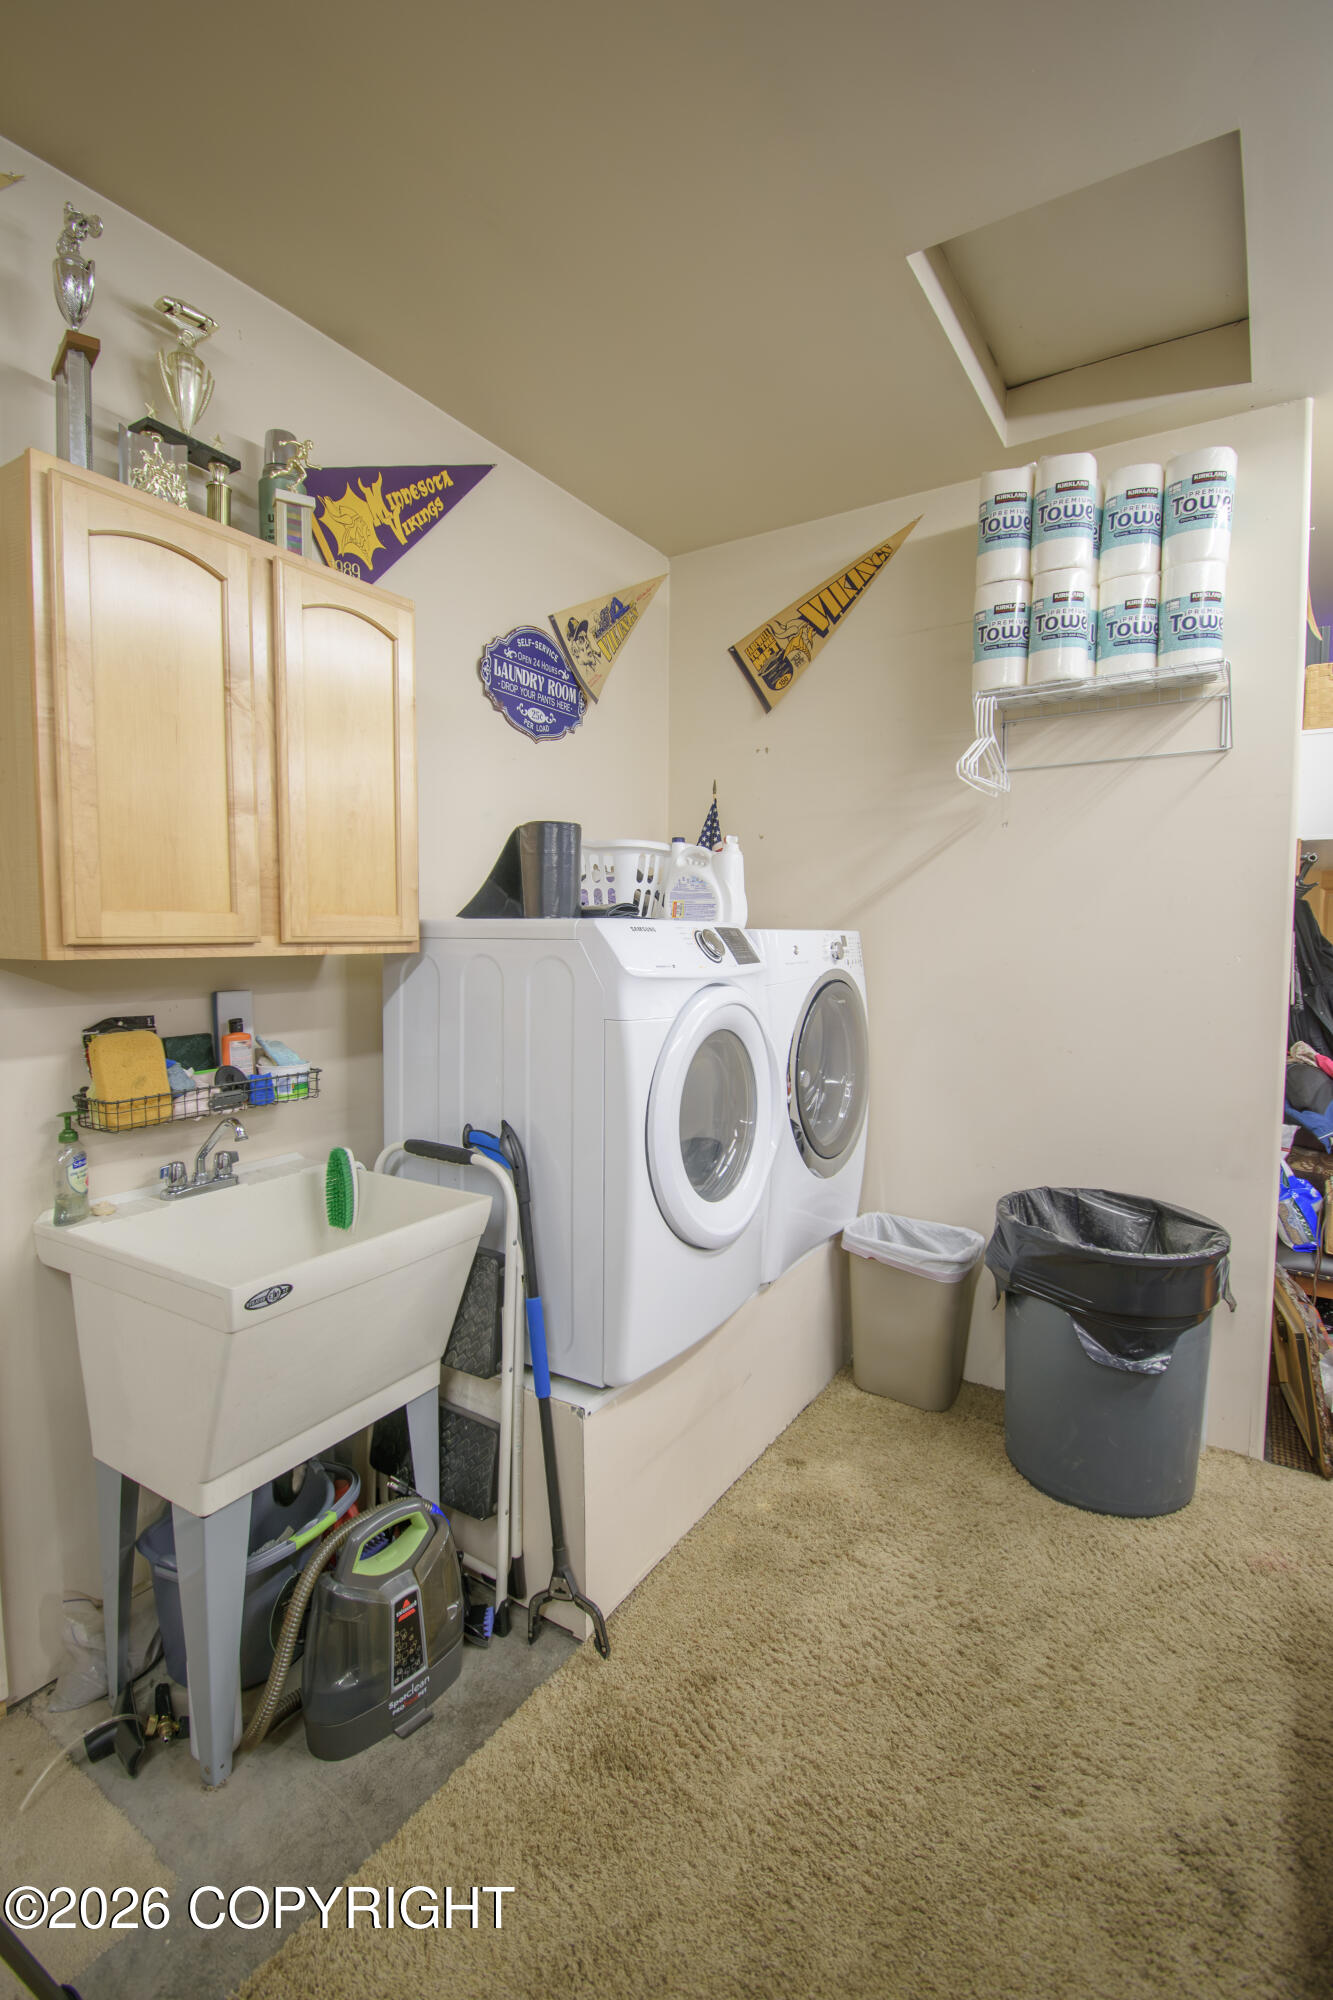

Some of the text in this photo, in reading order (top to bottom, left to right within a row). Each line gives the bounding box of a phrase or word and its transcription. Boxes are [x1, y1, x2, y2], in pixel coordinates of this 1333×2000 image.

[1193, 471, 1226, 480] KIRKLAND
[1057, 480, 1088, 489] KIRKLAND
[996, 492, 1026, 501] KIRKLAND
[1127, 488, 1157, 496] KIRKLAND
[1189, 488, 1229, 496] PREMIUM
[1053, 497, 1092, 505] PREMIUM
[1055, 591, 1084, 599] KIRKAND
[517, 638, 558, 662] SELF-SERVICE
[517, 652, 558, 675] OPEN 24 HOURS
[494, 658, 544, 692] LAUNDRY
[548, 679, 577, 704] ROOM
[501, 680, 518, 693] DROP
[520, 686, 536, 700] YOUR
[537, 694, 555, 707] PANTS
[524, 718, 550, 733] PER LOAD
